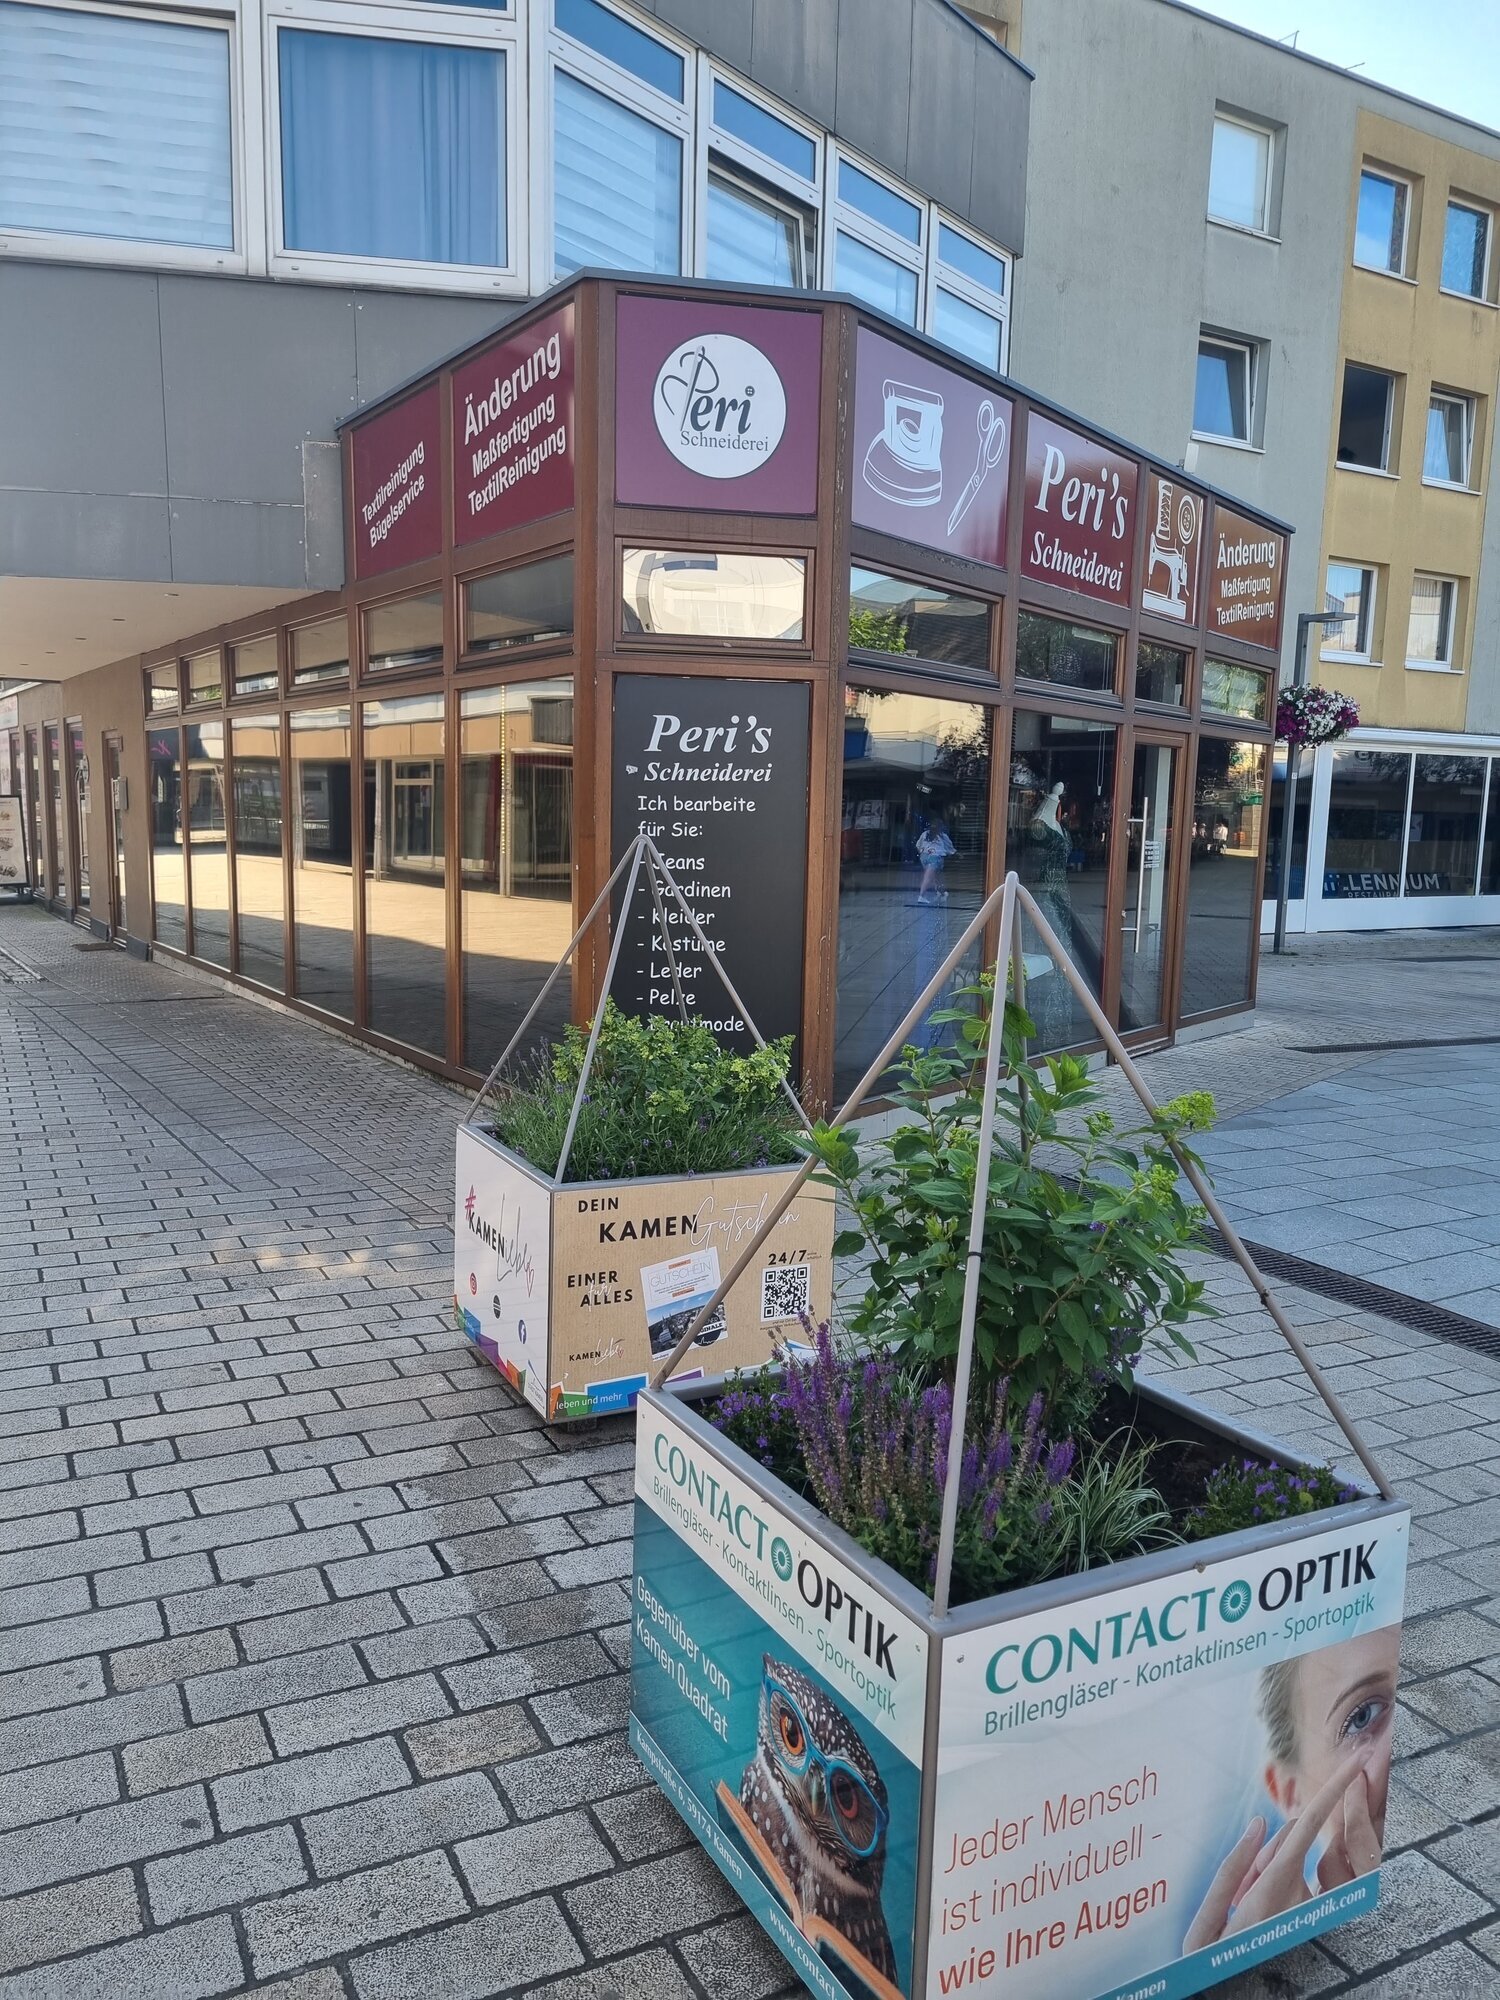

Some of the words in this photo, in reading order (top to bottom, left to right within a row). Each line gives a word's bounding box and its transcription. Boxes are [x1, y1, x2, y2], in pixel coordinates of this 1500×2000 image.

[464, 332, 562, 445] Änderung
[661, 345, 756, 434] Peri
[472, 393, 556, 478] Maßfertigung
[680, 430, 769, 452] Schneiderei
[362, 440, 425, 525] Textilreinigung
[468, 425, 567, 515] TextilReinigung
[1033, 442, 1129, 540] Peri's
[369, 474, 425, 548] Bügelservice
[1030, 530, 1124, 592] Schneiderei
[1217, 533, 1276, 569] Änderung
[1216, 600, 1275, 626] TextilReinigung
[1220, 575, 1271, 599] Maßfertigung
[643, 714, 773, 754] Peri's
[637, 795, 667, 812] Ich
[674, 795, 757, 812] bearbeite
[643, 761, 773, 782] Schneiderei
[638, 821, 665, 837] für
[671, 822, 704, 838] Sie:
[650, 962, 702, 979] Leder
[578, 1197, 619, 1213] DEIN
[599, 1215, 698, 1243] KAMEN
[567, 1270, 619, 1288] EINER
[650, 1262, 712, 1288] GUTSCHEIN
[768, 1250, 807, 1265] 24/7
[580, 1289, 633, 1308] ALLES
[569, 1350, 601, 1362] KAMEN
[556, 1397, 580, 1410] leben
[582, 1395, 599, 1406] und
[600, 1393, 623, 1404] mehr
[654, 1433, 769, 1562] CONTACT
[797, 1559, 899, 1682] OPTIK
[653, 1475, 713, 1548] Brillengläser
[721, 1542, 806, 1635] Kontaktlinsen
[816, 1629, 898, 1721] Sportoptik
[984, 1585, 1216, 1696] CONTACT
[1257, 1539, 1379, 1612] OPTIK
[636, 1575, 700, 1664] Gegenüber
[702, 1652, 731, 1701] vom
[984, 1672, 1119, 1737] Brillengläser
[1135, 1627, 1268, 1688] Kontaktlinsen
[1283, 1592, 1376, 1643] Sportoptik
[636, 1612, 676, 1680] Kamen
[676, 1662, 729, 1744] Quadrat
[636, 1729, 678, 1793] Kampstraße
[686, 1798, 712, 1839] 59174
[712, 1831, 744, 1881] Kamen
[944, 1812, 1033, 1875] Jeder
[1043, 1764, 1159, 1836] Mensch
[942, 1889, 981, 1935] ist
[991, 1823, 1144, 1915] individuell
[938, 1947, 996, 1995] wie
[1006, 1920, 1066, 1969] Ihre
[1074, 1878, 1168, 1940] Augen
[1210, 1884, 1367, 1969] www.contact-optik.com
